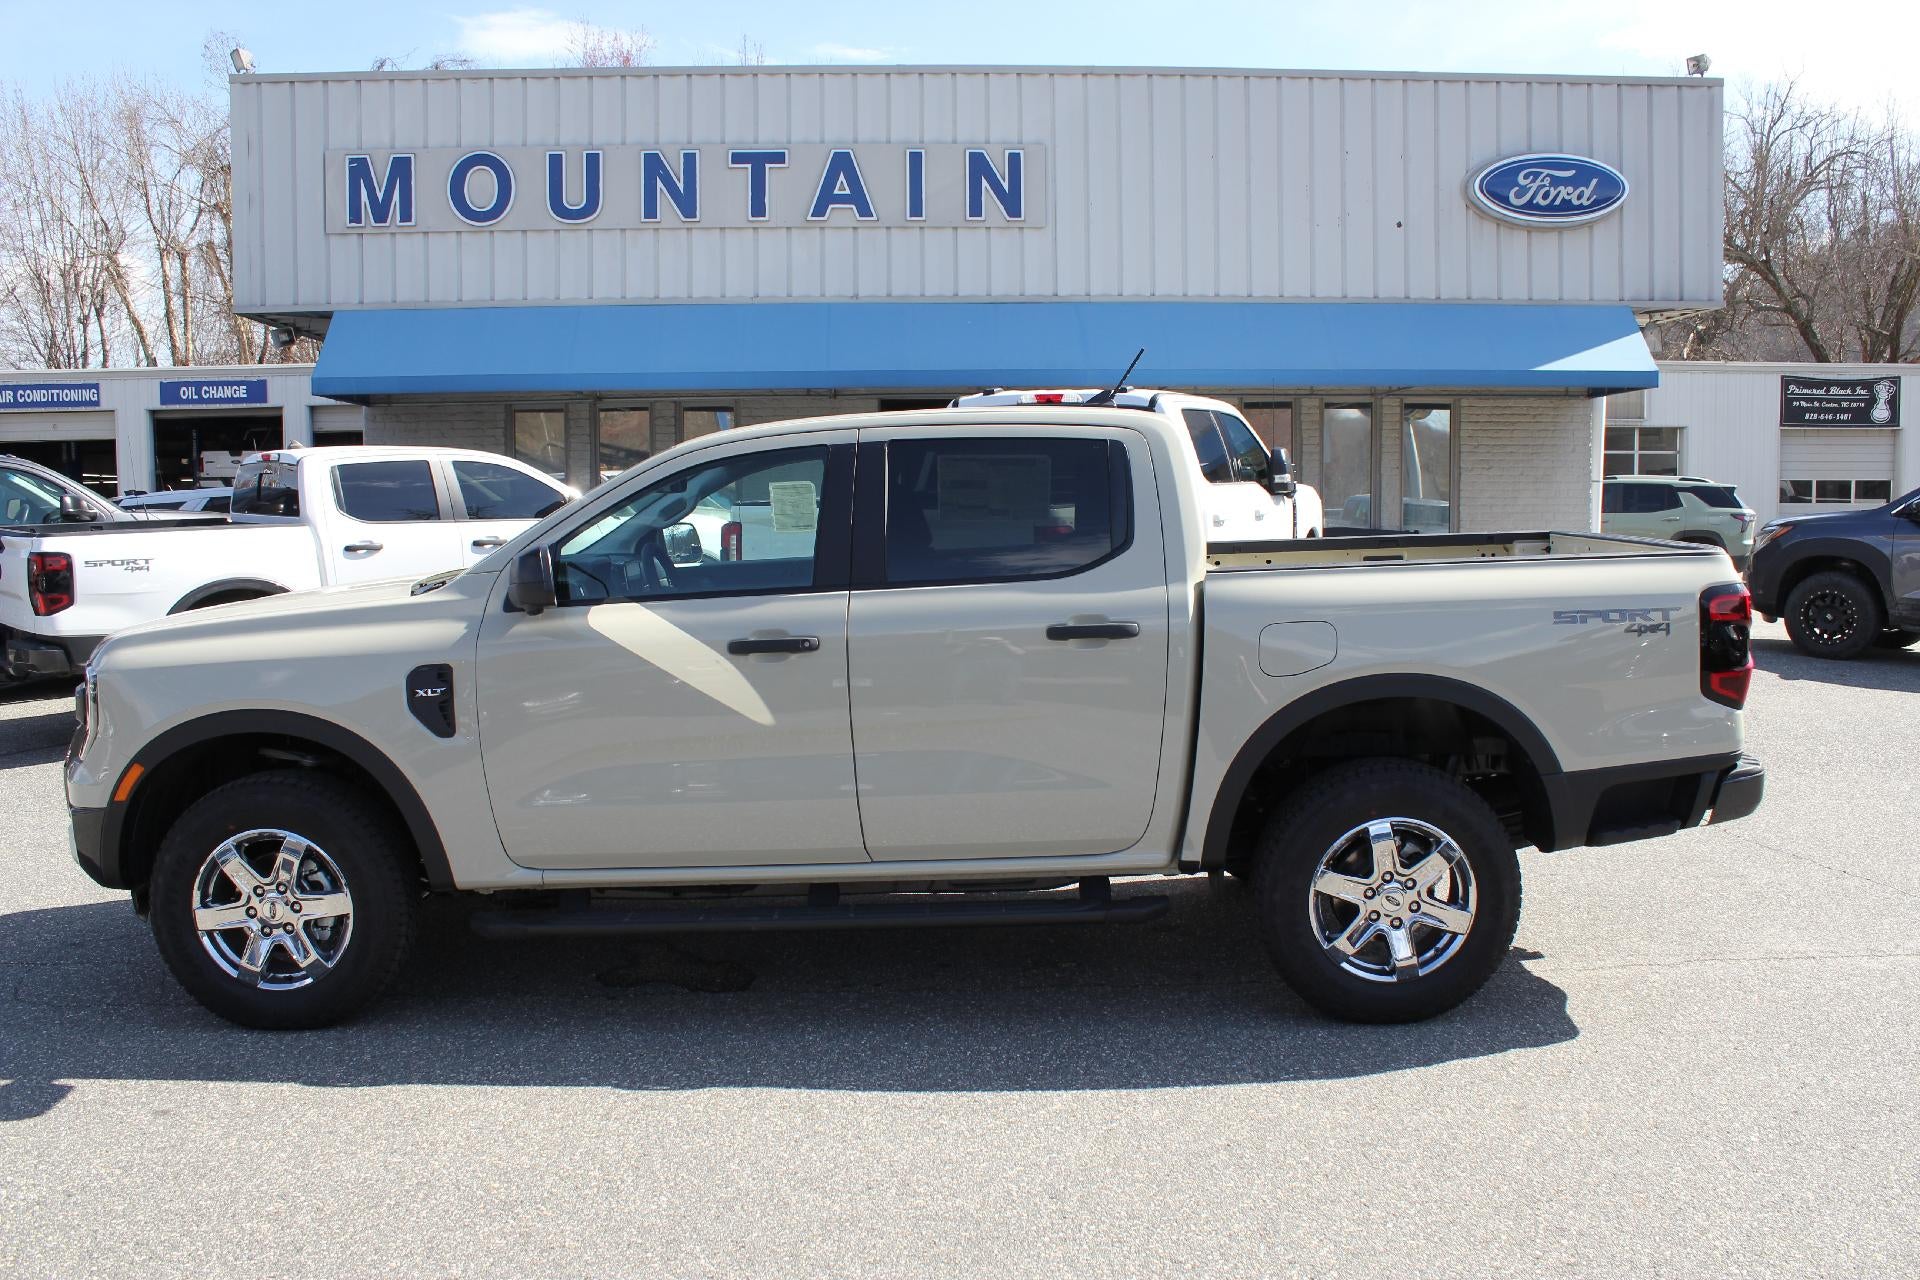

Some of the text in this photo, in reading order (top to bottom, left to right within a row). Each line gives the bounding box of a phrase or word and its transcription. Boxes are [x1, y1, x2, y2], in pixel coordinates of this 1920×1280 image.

[345, 149, 1025, 227] MOUNTAIN
[1508, 168, 1599, 206] Ford
[17, 388, 98, 402] CONDITIONING
[180, 385, 247, 400] OIL CHANGE
[1828, 386, 1853, 395] Black
[84, 558, 154, 568] SPORT
[1552, 607, 1682, 625] SPORT
[414, 687, 447, 698] XLT
